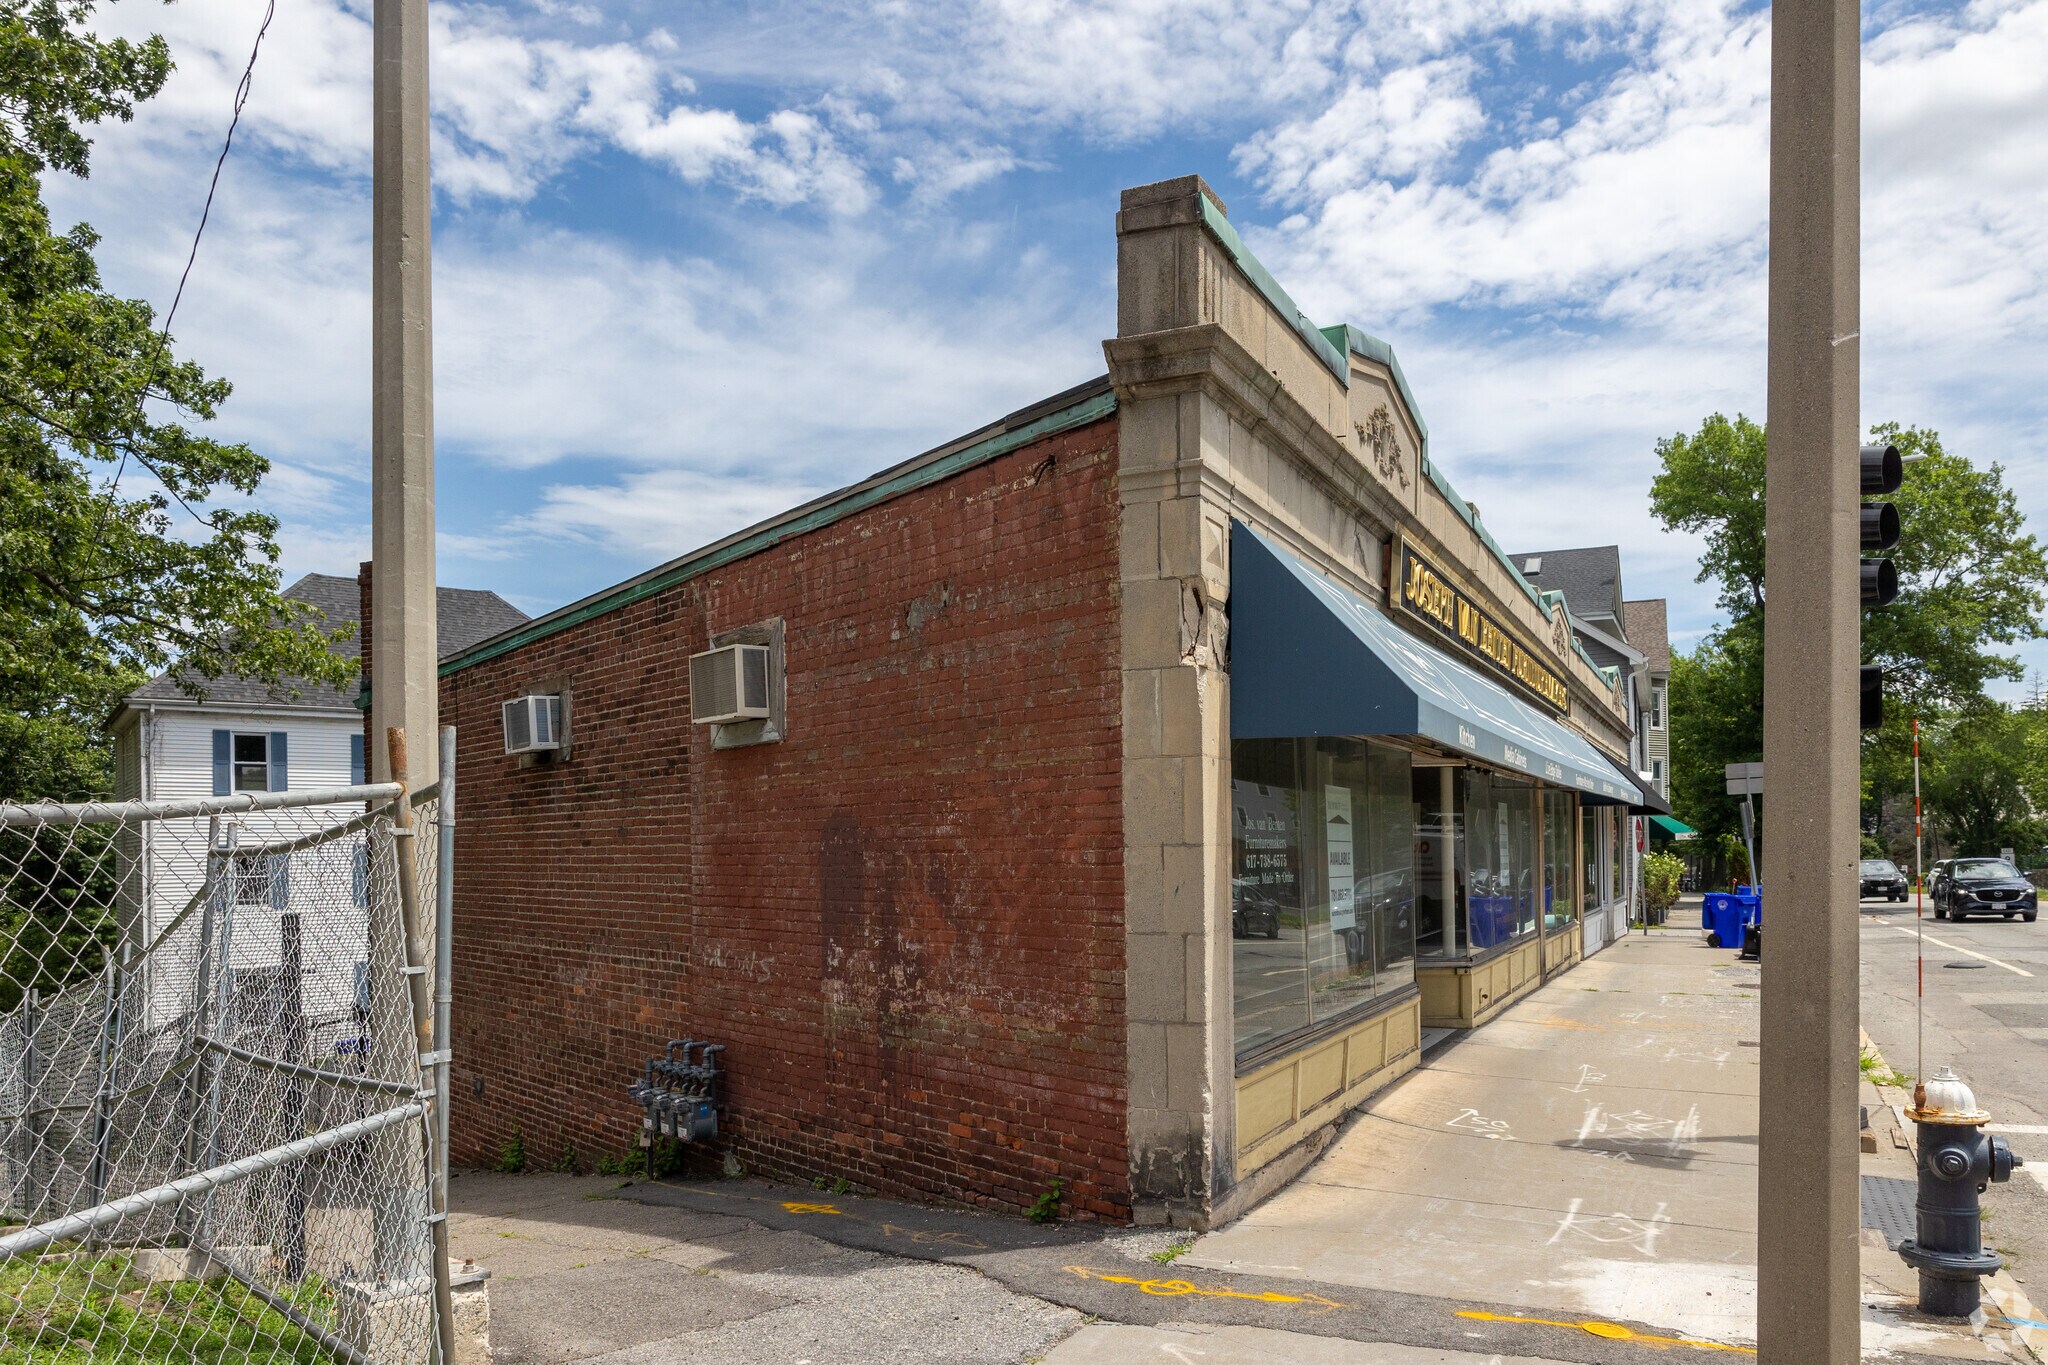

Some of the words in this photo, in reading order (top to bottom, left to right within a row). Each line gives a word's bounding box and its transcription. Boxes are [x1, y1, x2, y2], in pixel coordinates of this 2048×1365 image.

[1405, 556, 1456, 630] JOSEPH
[1457, 596, 1480, 647] VAN
[1459, 724, 1476, 750] Kitchen
[1256, 820, 1266, 830] van
[1245, 834, 1287, 849] Furnituremakers
[1246, 854, 1288, 869] 617-738-6575
[1330, 851, 1351, 866] AVAILABLE
[1261, 872, 1274, 884] Made
